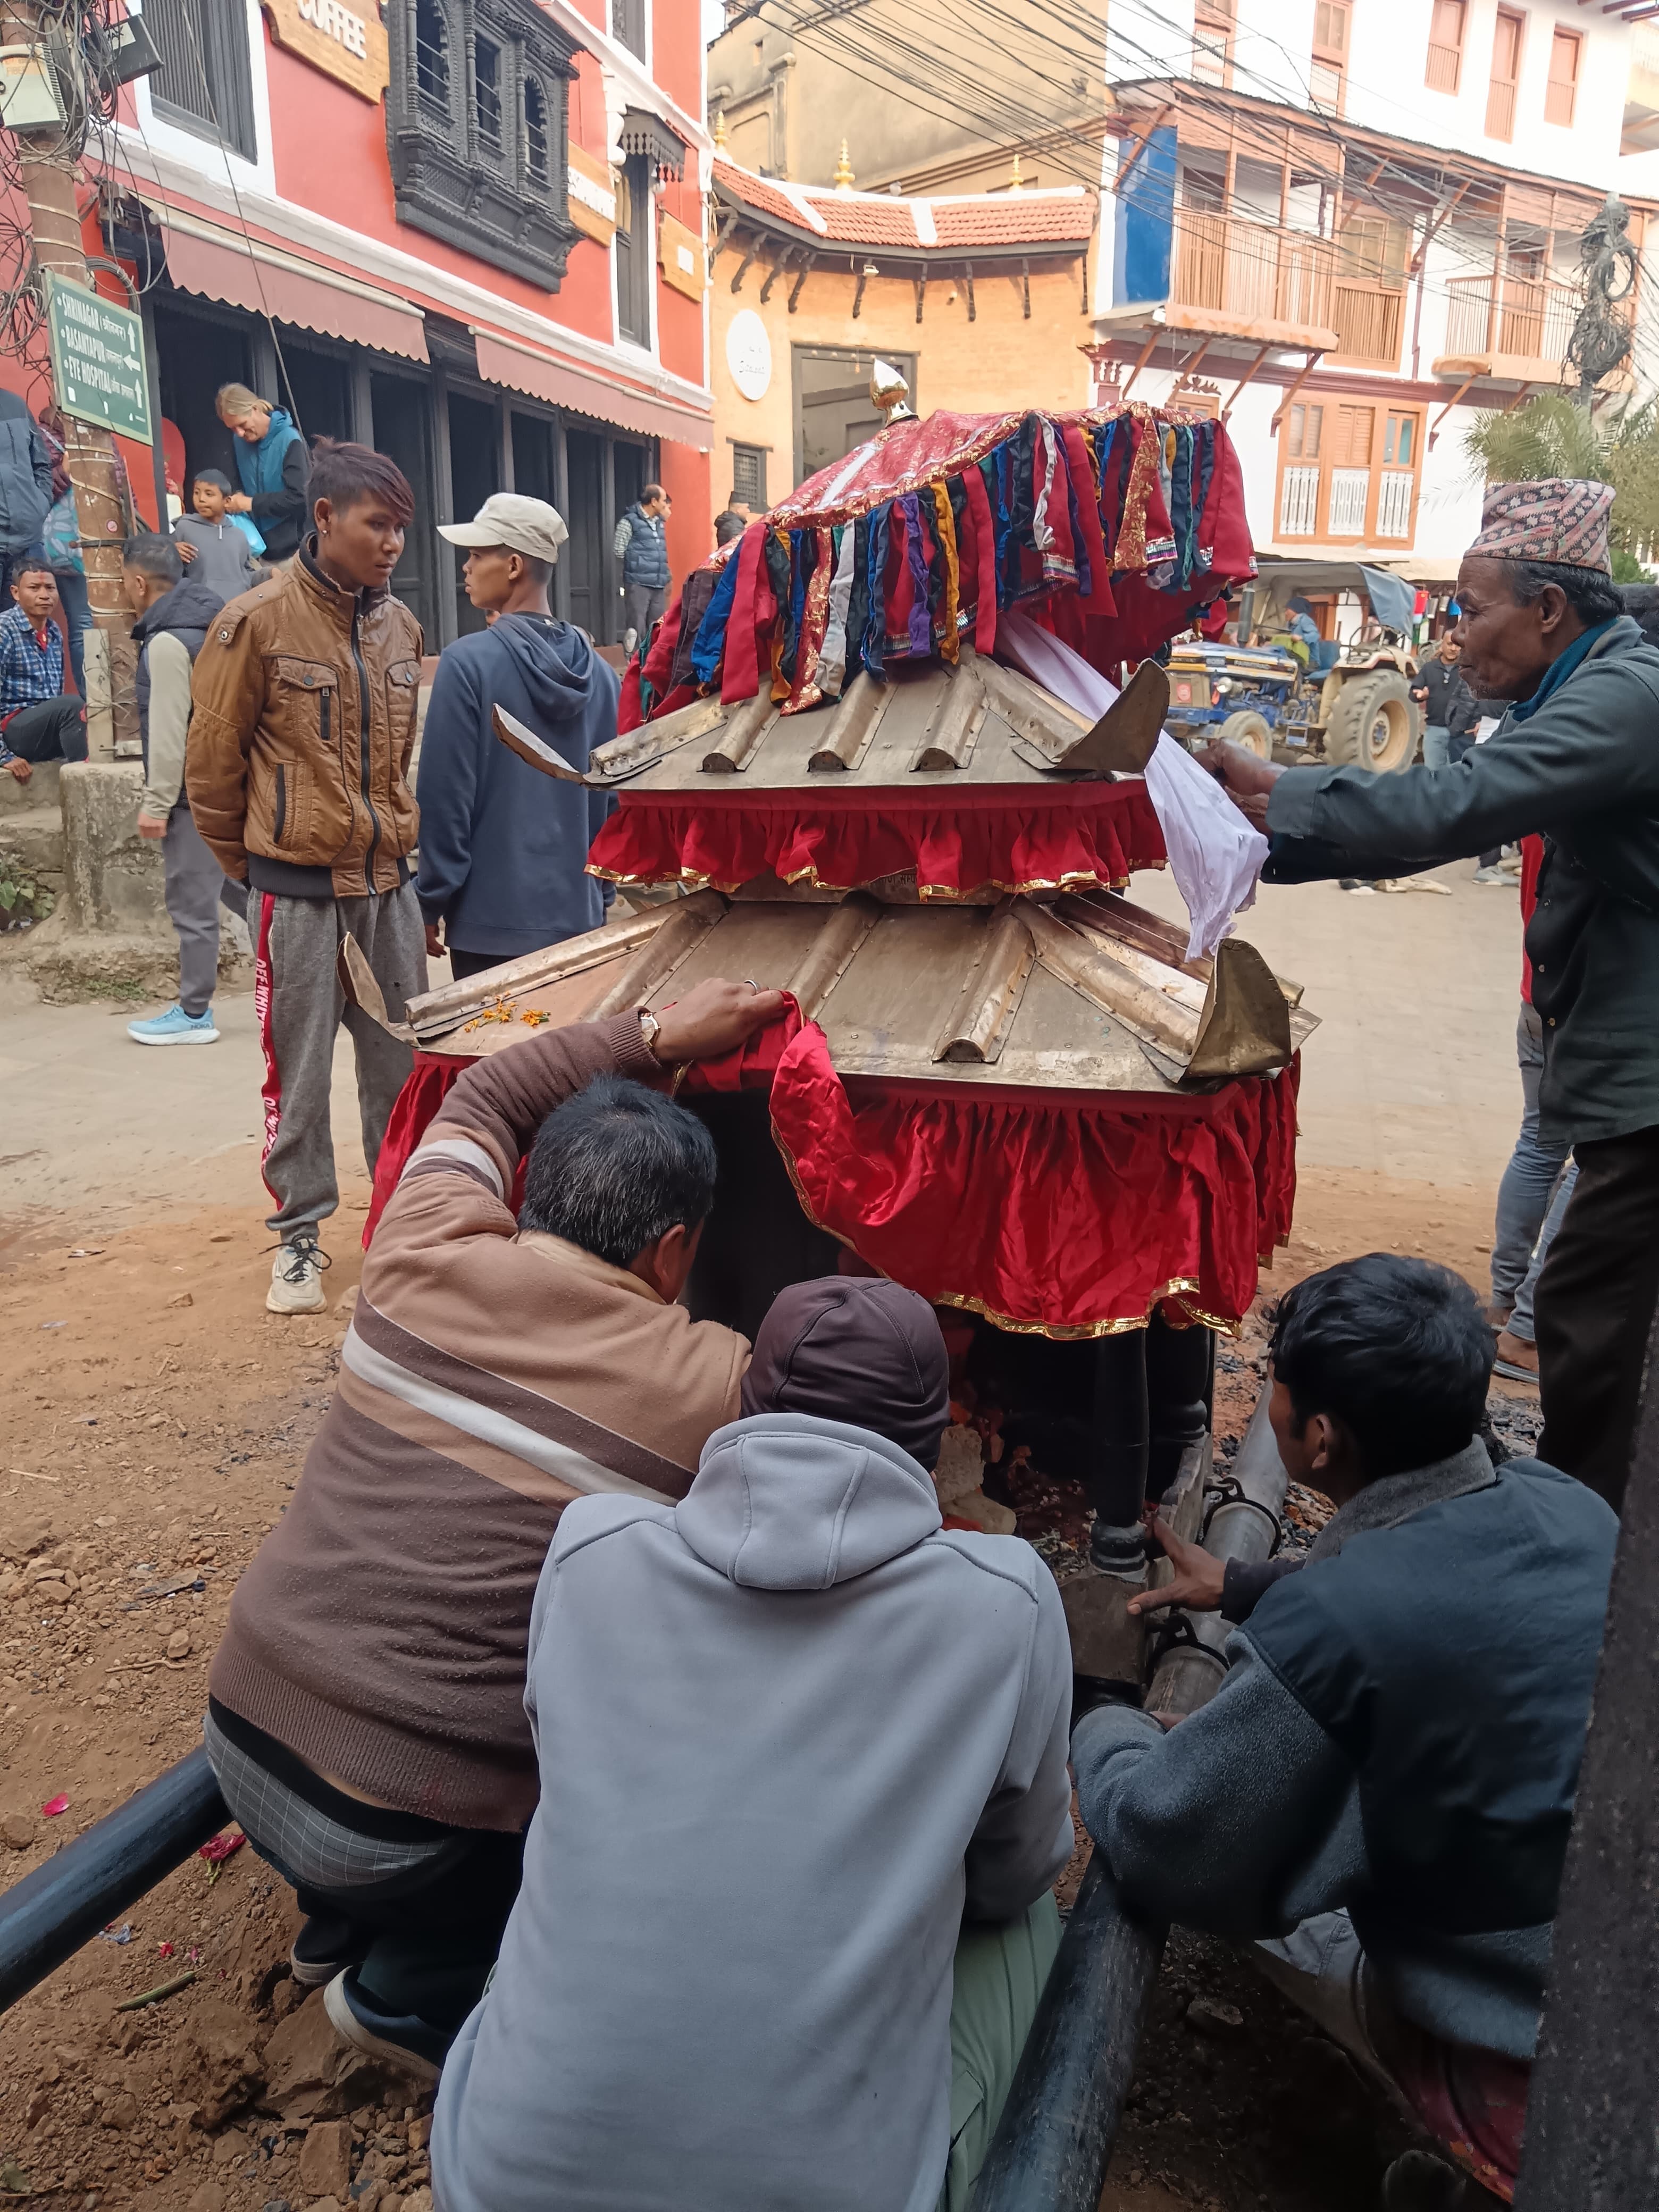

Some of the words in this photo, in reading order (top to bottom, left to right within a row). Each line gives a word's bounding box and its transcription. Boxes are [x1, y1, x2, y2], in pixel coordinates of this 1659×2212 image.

[62, 292, 100, 332] SHRINAGAR
[65, 325, 106, 363] BASANTAPUR
[68, 355, 81, 382] EYE
[81, 361, 112, 394] HOSPITAL
